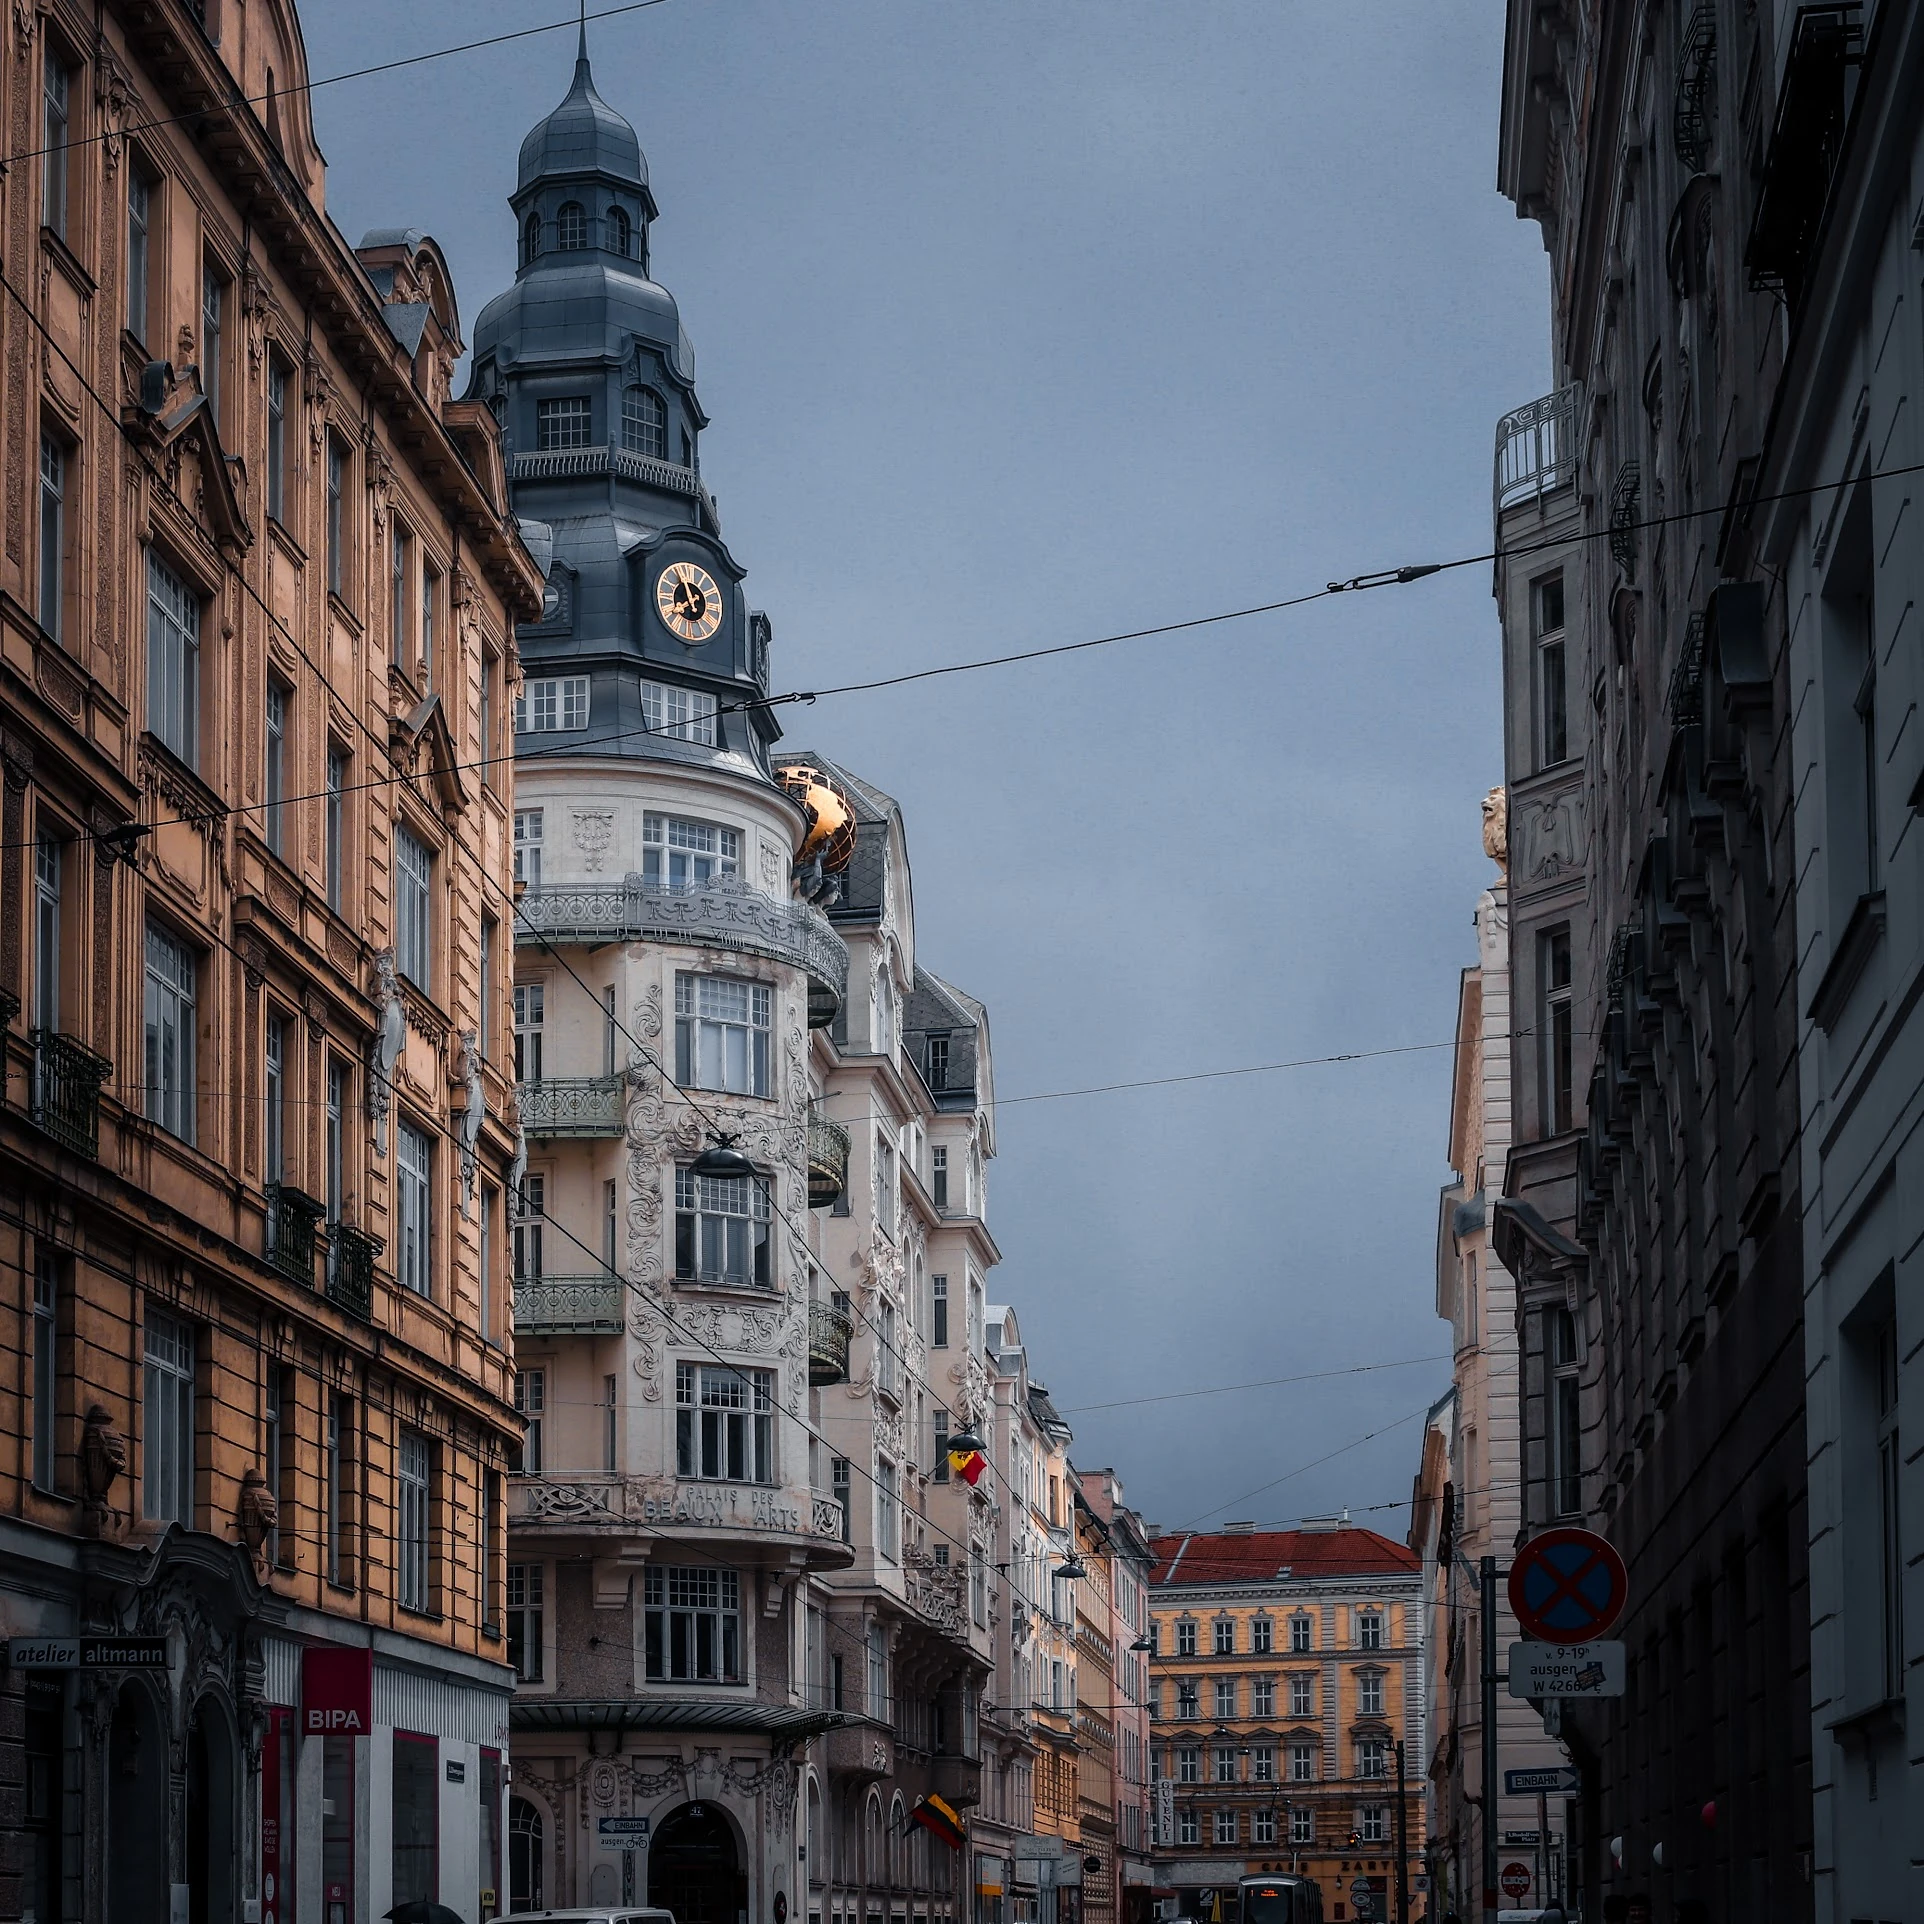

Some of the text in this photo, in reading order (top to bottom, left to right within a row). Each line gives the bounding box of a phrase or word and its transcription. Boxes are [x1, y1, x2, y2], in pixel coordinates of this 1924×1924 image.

[686, 1486, 774, 1505] PALAIS DES
[645, 1500, 800, 1527] BEAUX ARTS
[16, 1643, 163, 1663] atelier altmann
[1533, 1681, 1545, 1692] W
[1548, 1680, 1582, 1692] 4266
[308, 1709, 362, 1729] BIPA
[1515, 1774, 1558, 1787] EINBAHN
